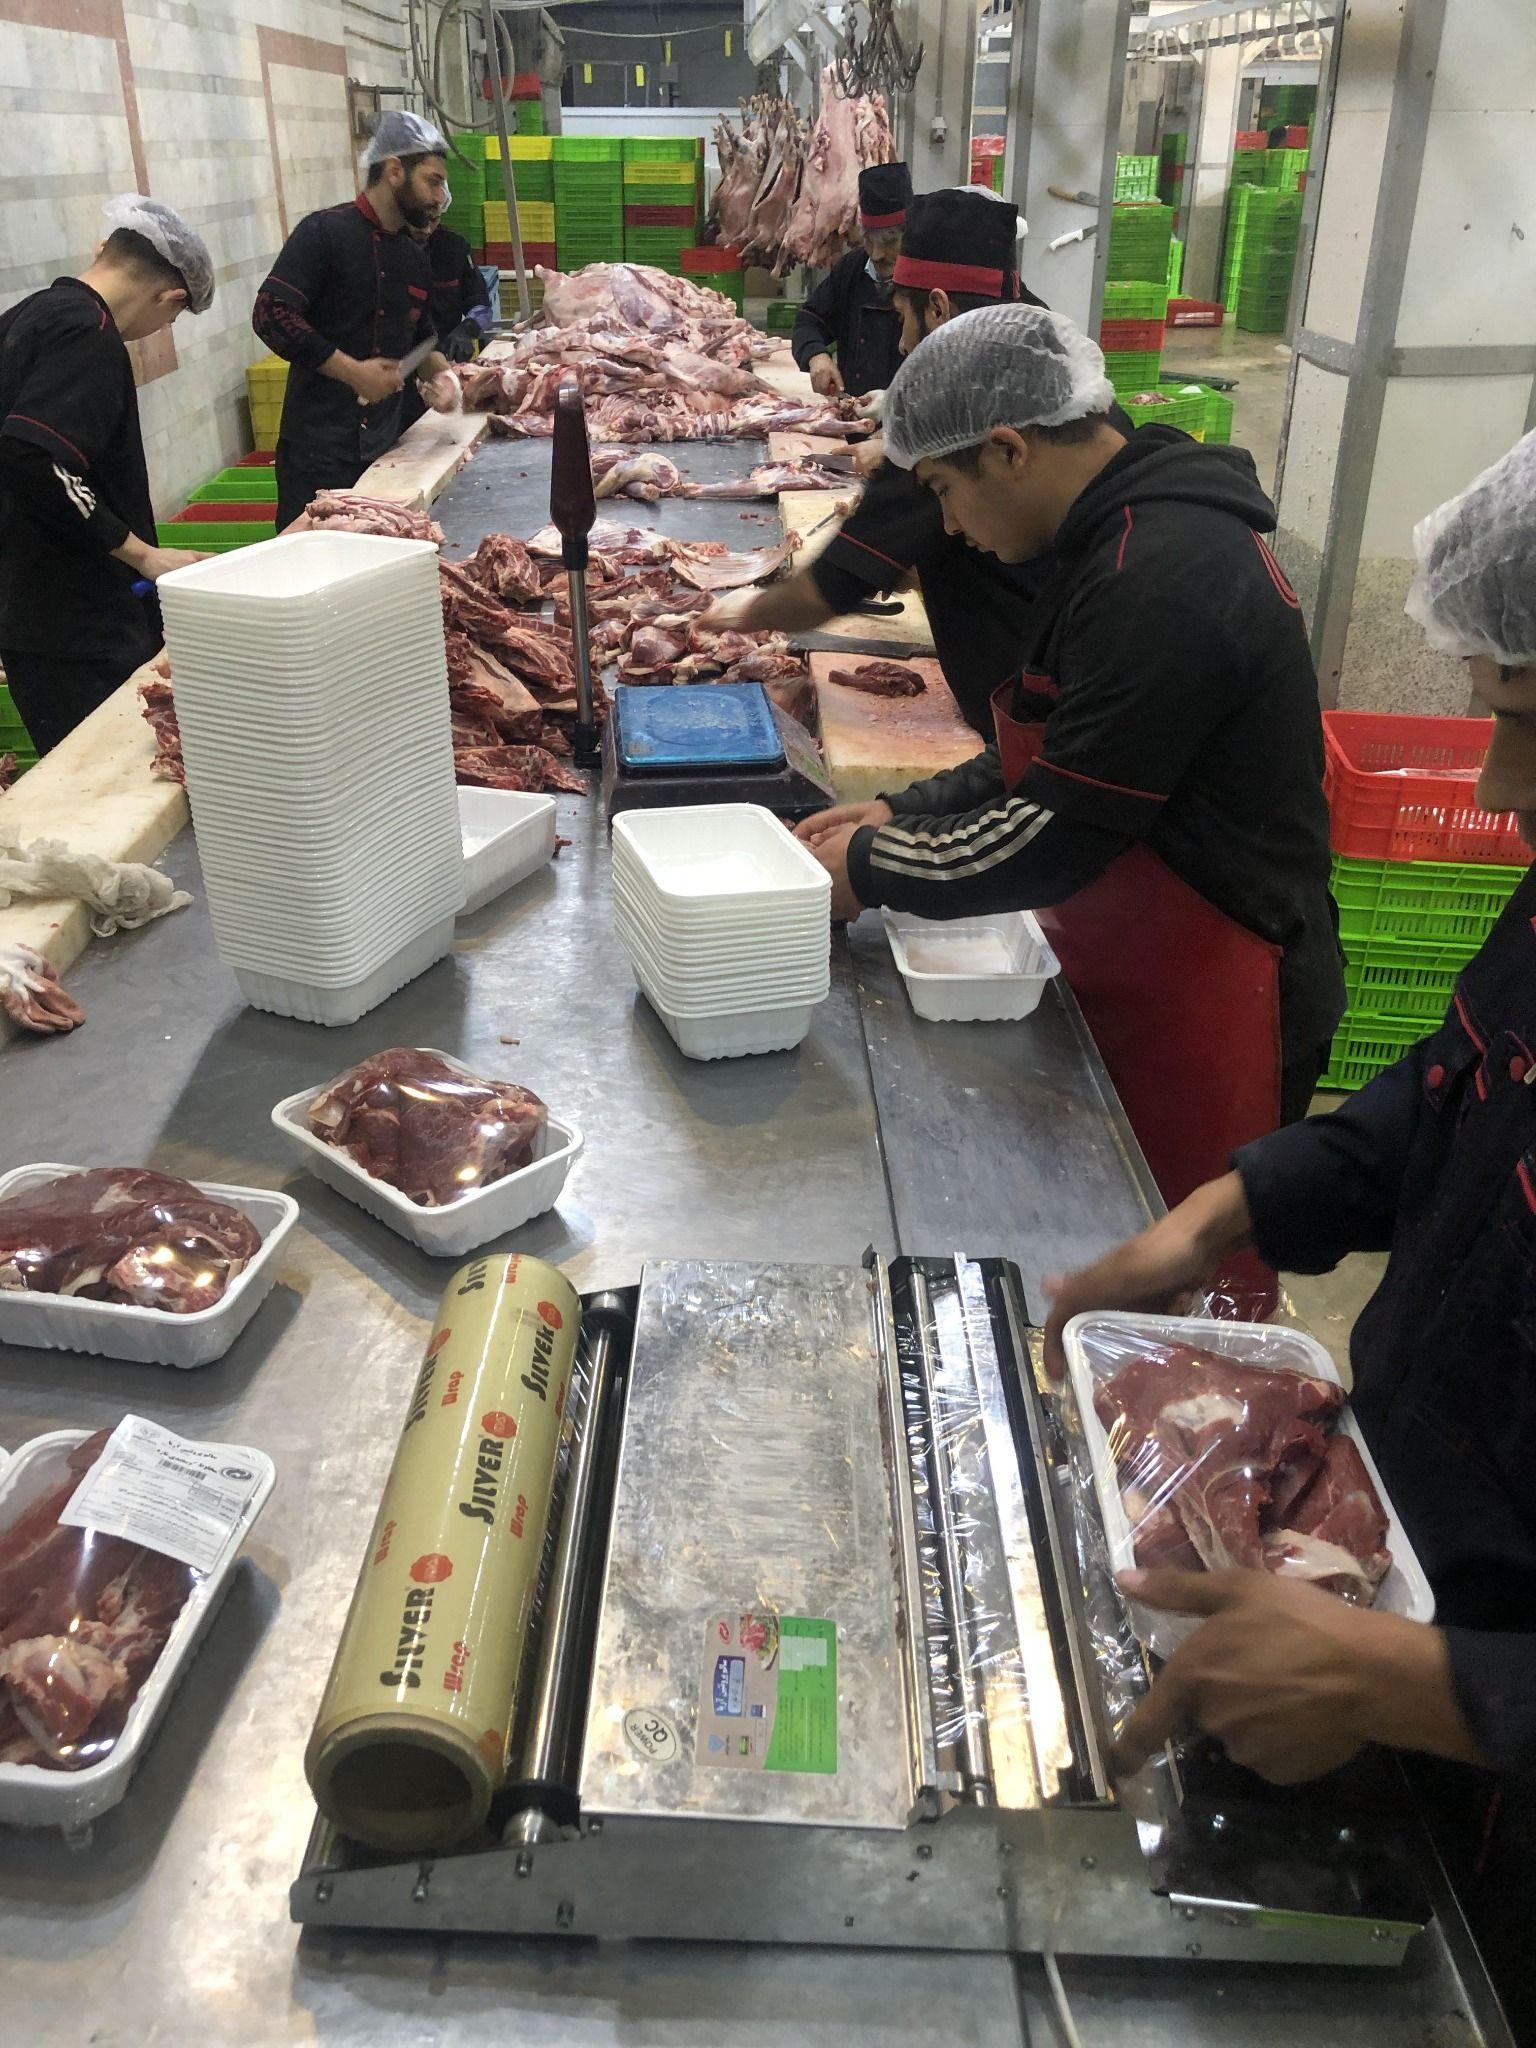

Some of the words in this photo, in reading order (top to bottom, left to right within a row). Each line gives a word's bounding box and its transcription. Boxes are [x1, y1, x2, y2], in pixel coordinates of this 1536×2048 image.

[521, 1324, 555, 1402] SILVER
[441, 1371, 464, 1407] Wrap
[459, 1438, 504, 1525] SILVER
[510, 1494, 529, 1539] Wrap
[373, 1520, 397, 1566] Wrap
[379, 1587, 435, 1688] SILVER
[443, 1640, 470, 1692] Wrap
[631, 1723, 657, 1755] POWER
[645, 1720, 668, 1743] QC
